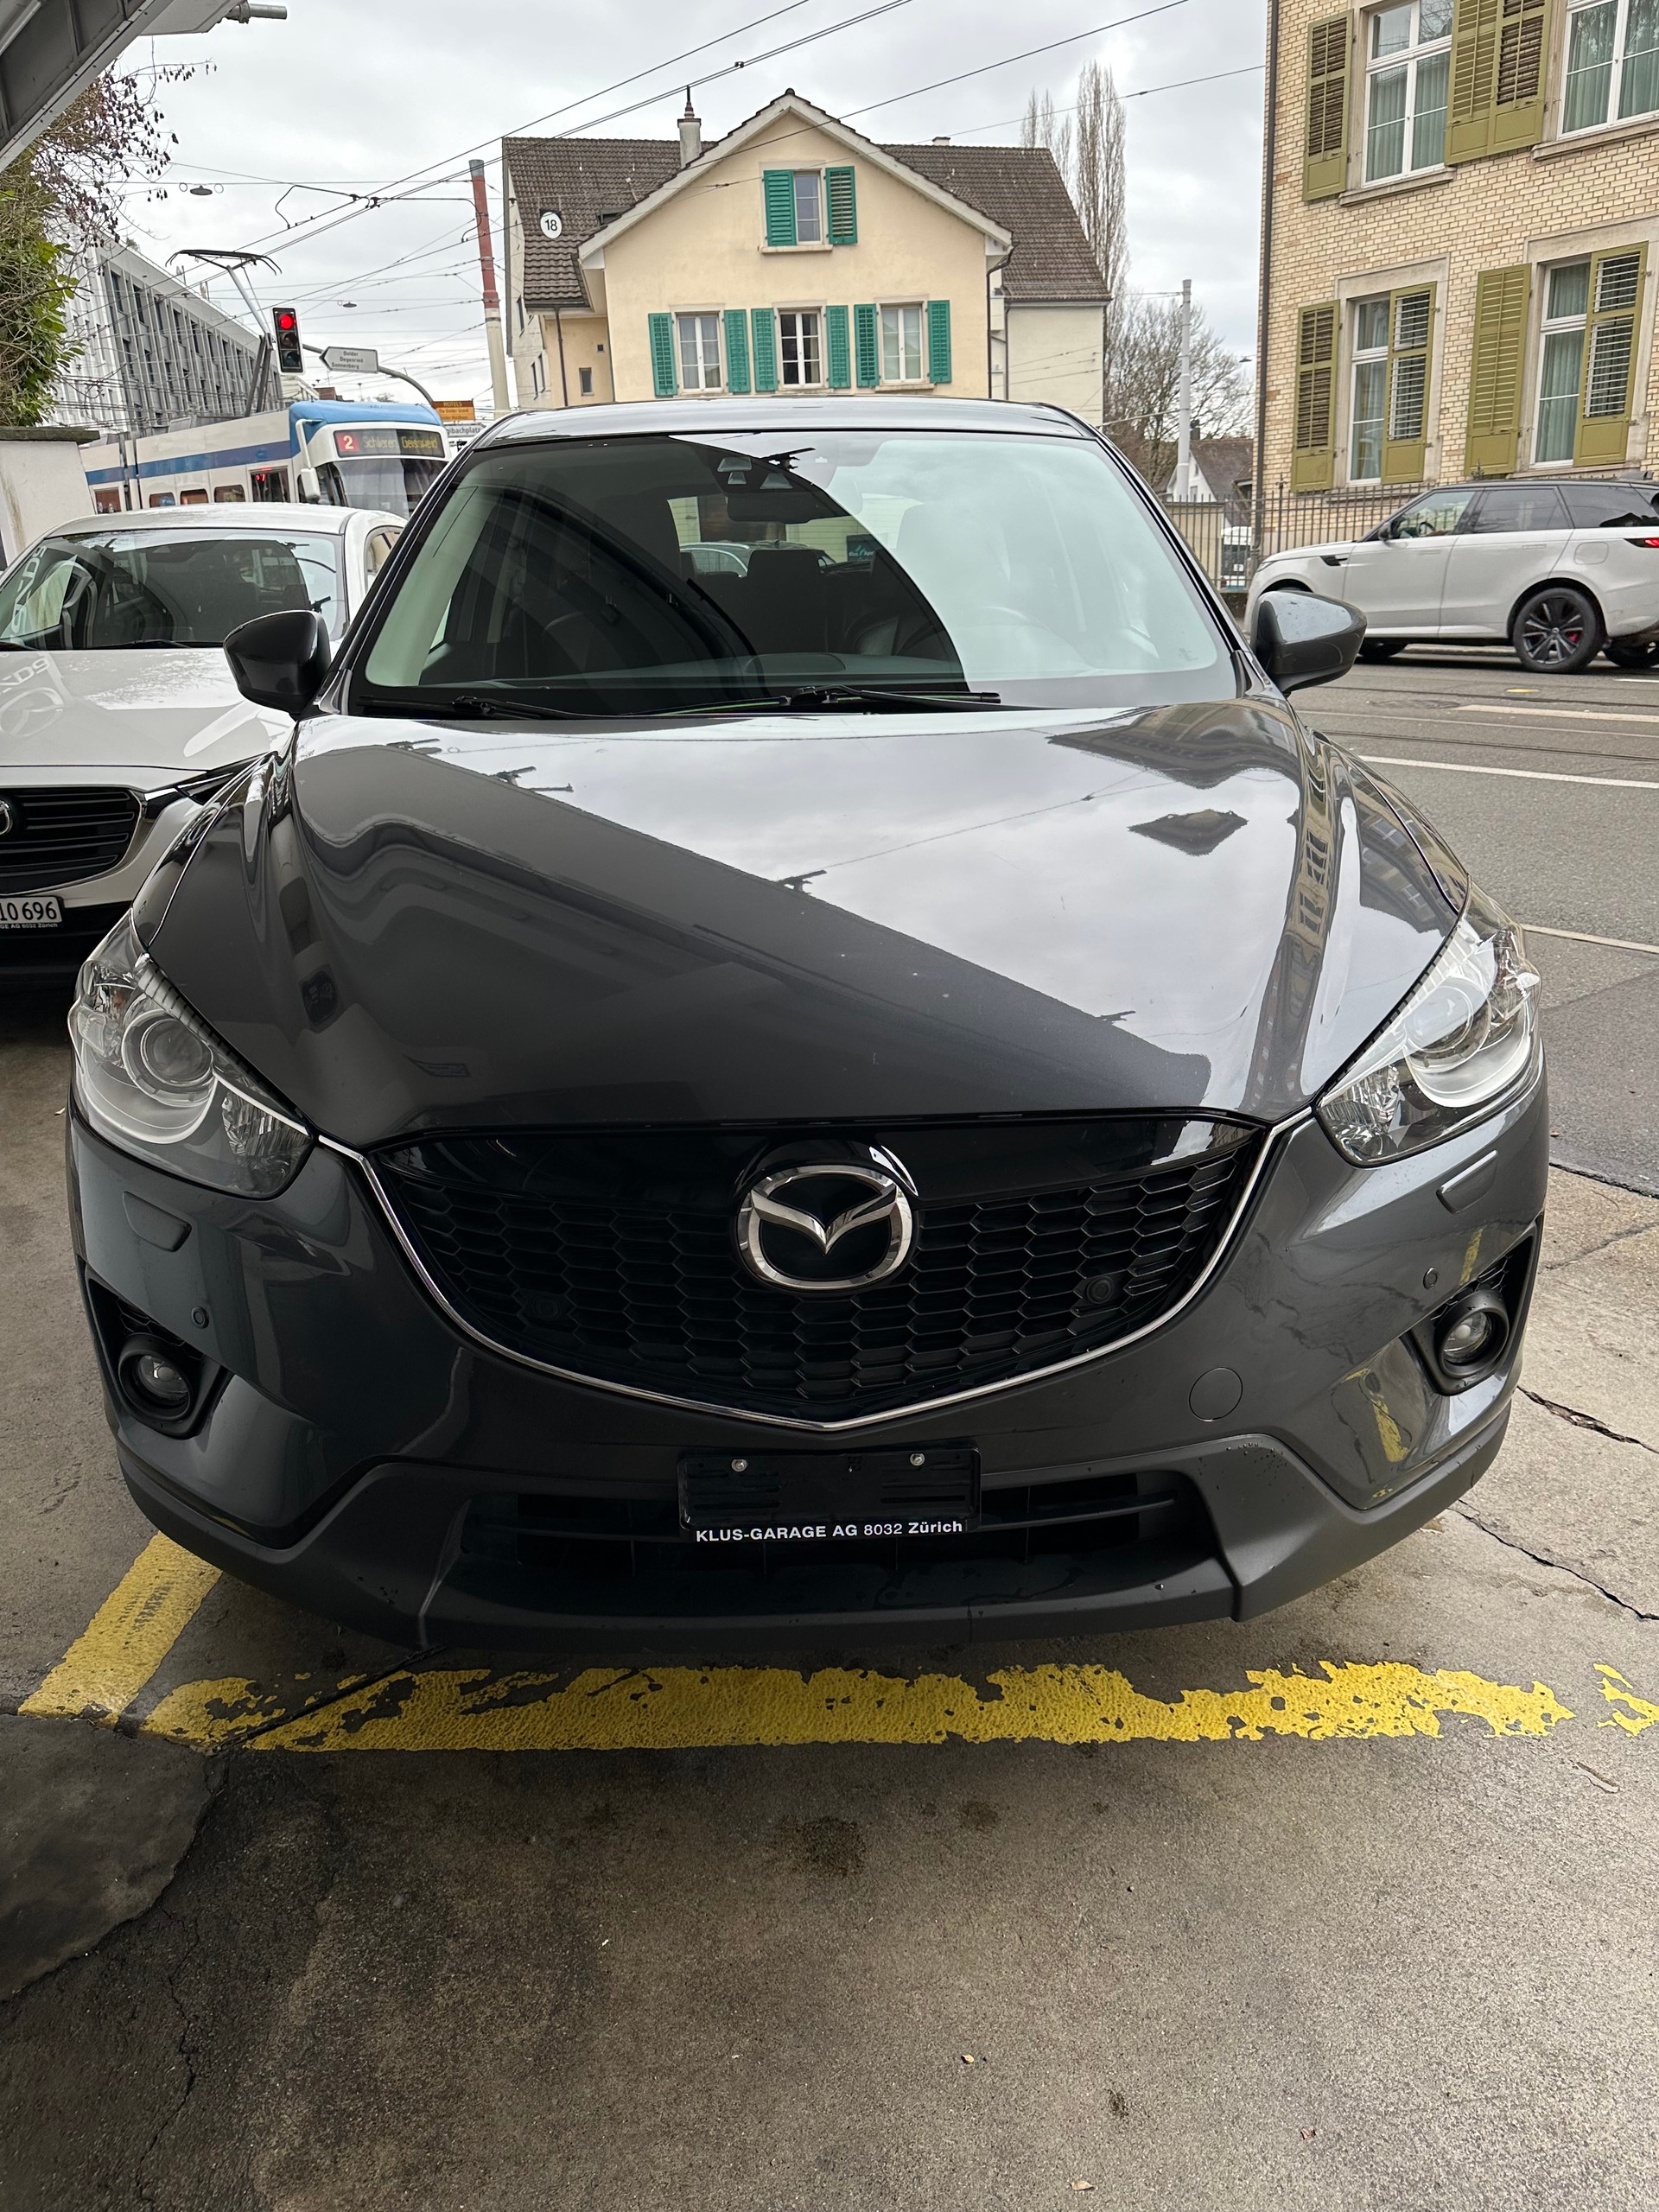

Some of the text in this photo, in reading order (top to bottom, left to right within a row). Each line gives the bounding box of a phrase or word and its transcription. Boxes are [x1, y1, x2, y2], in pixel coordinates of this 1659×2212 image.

[544, 219, 558, 232] 18
[343, 435, 354, 449] 2
[22, 901, 57, 920] 696
[696, 1521, 963, 1542] KLUS-GARAGE AG 8032 Zürich
